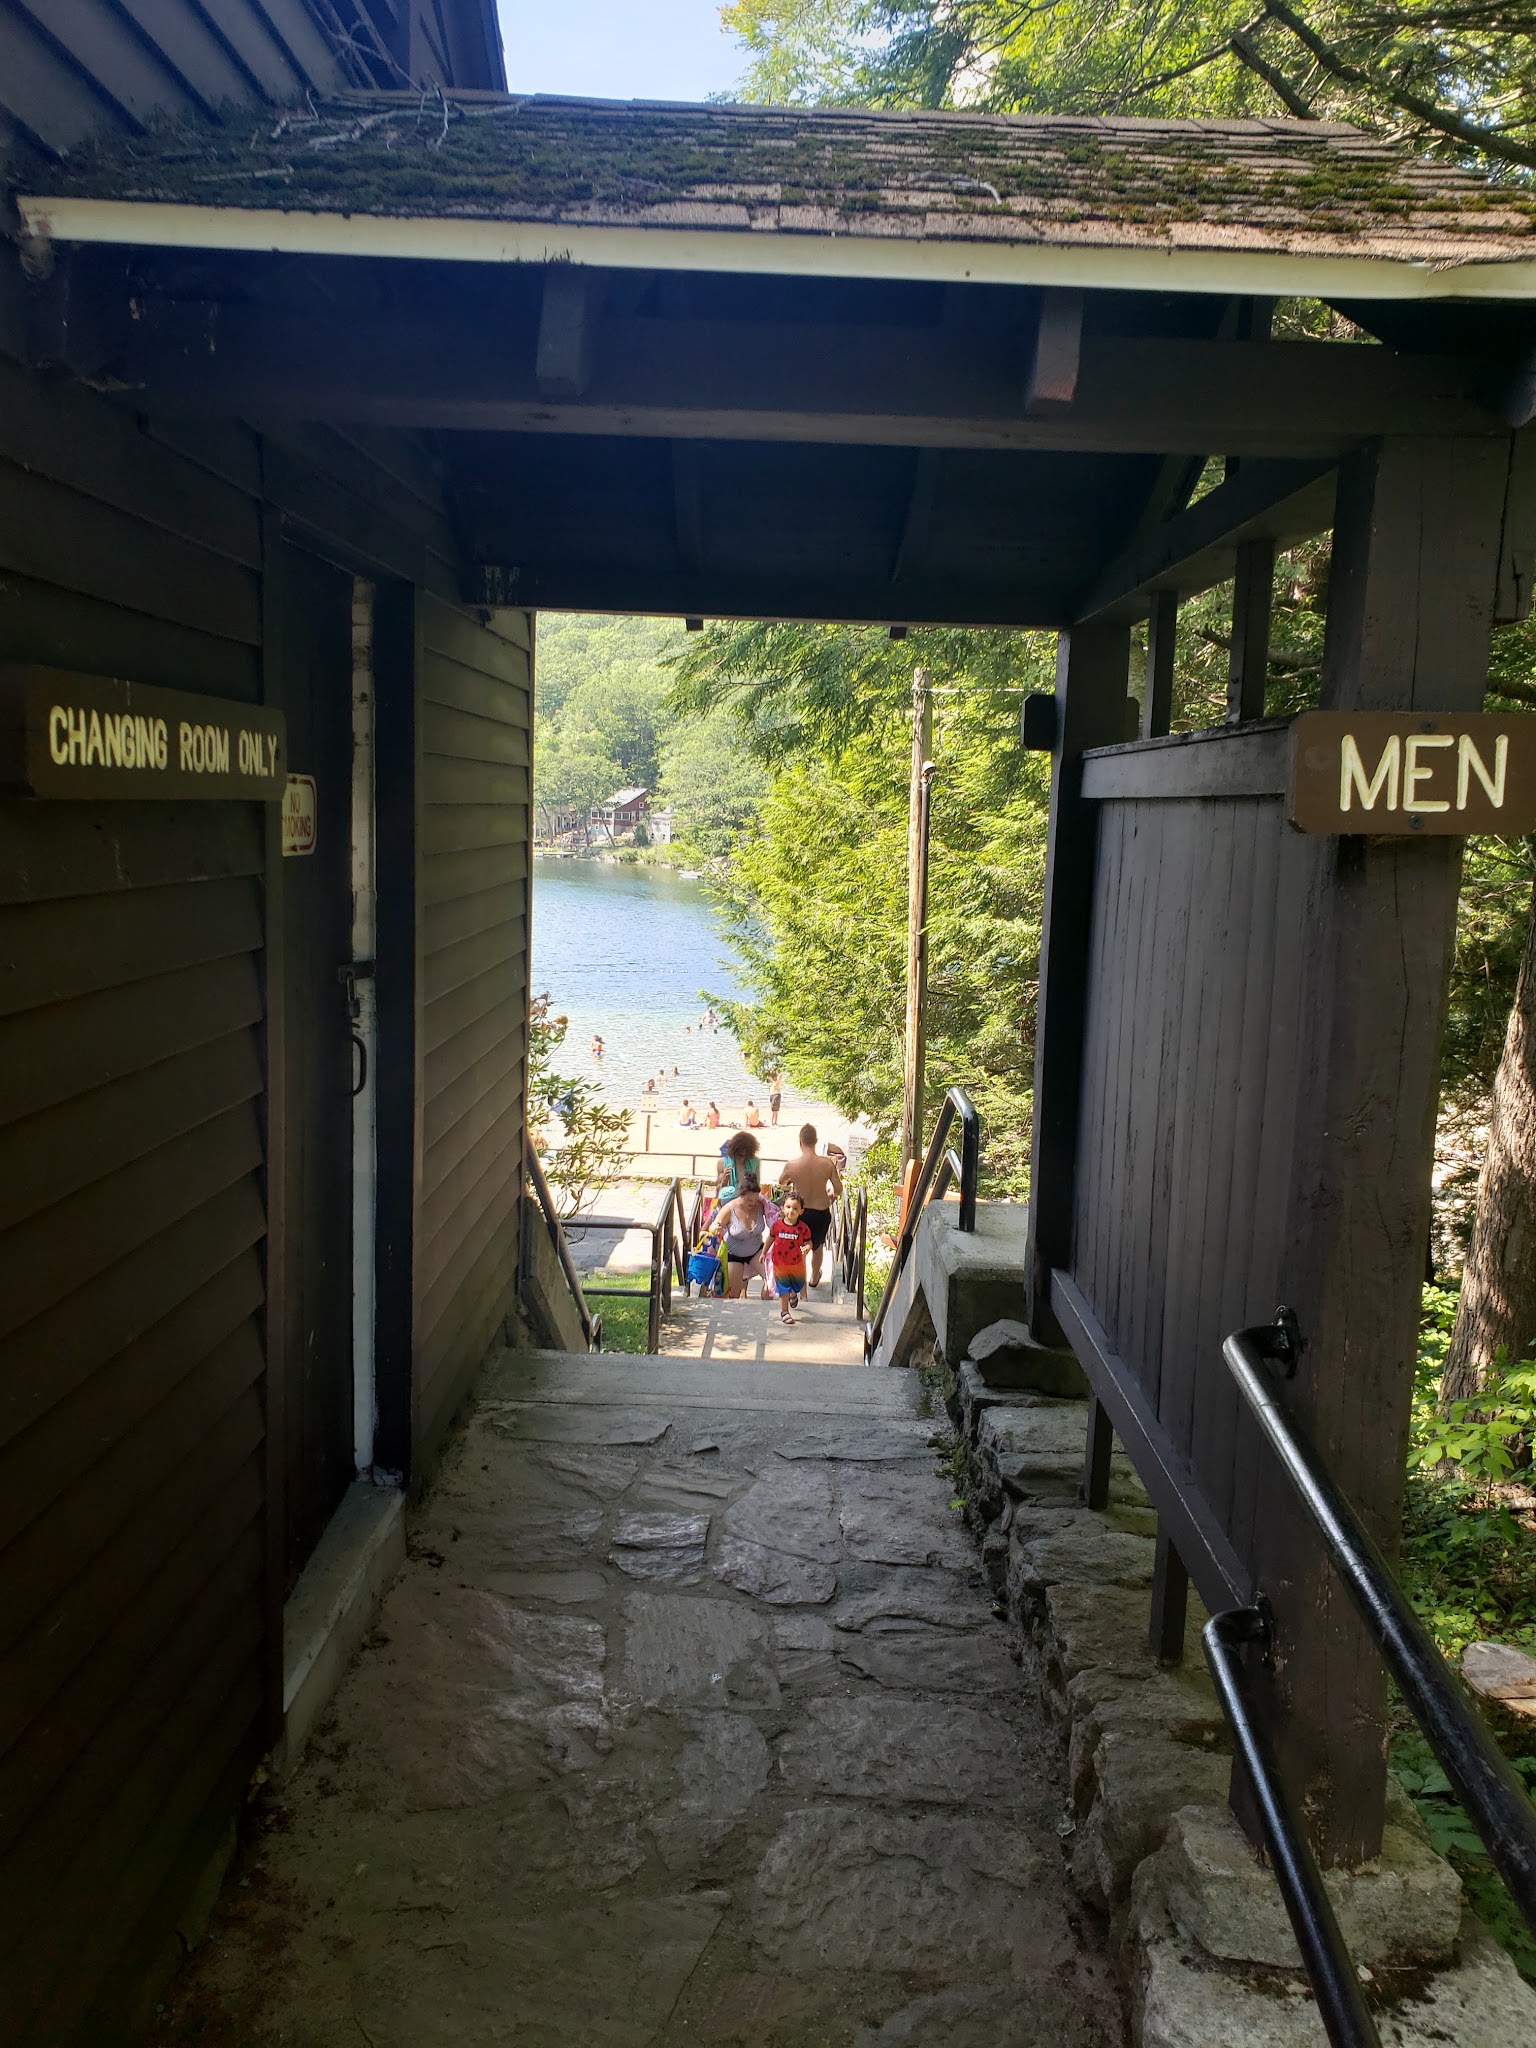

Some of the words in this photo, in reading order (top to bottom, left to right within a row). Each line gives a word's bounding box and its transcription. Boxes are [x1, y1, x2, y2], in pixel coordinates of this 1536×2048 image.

[50, 705, 168, 770] CHANGING
[180, 722, 229, 774] ROOM
[239, 729, 277, 777] ONLY
[1340, 734, 1509, 812] MEN
[290, 792, 301, 813] NO
